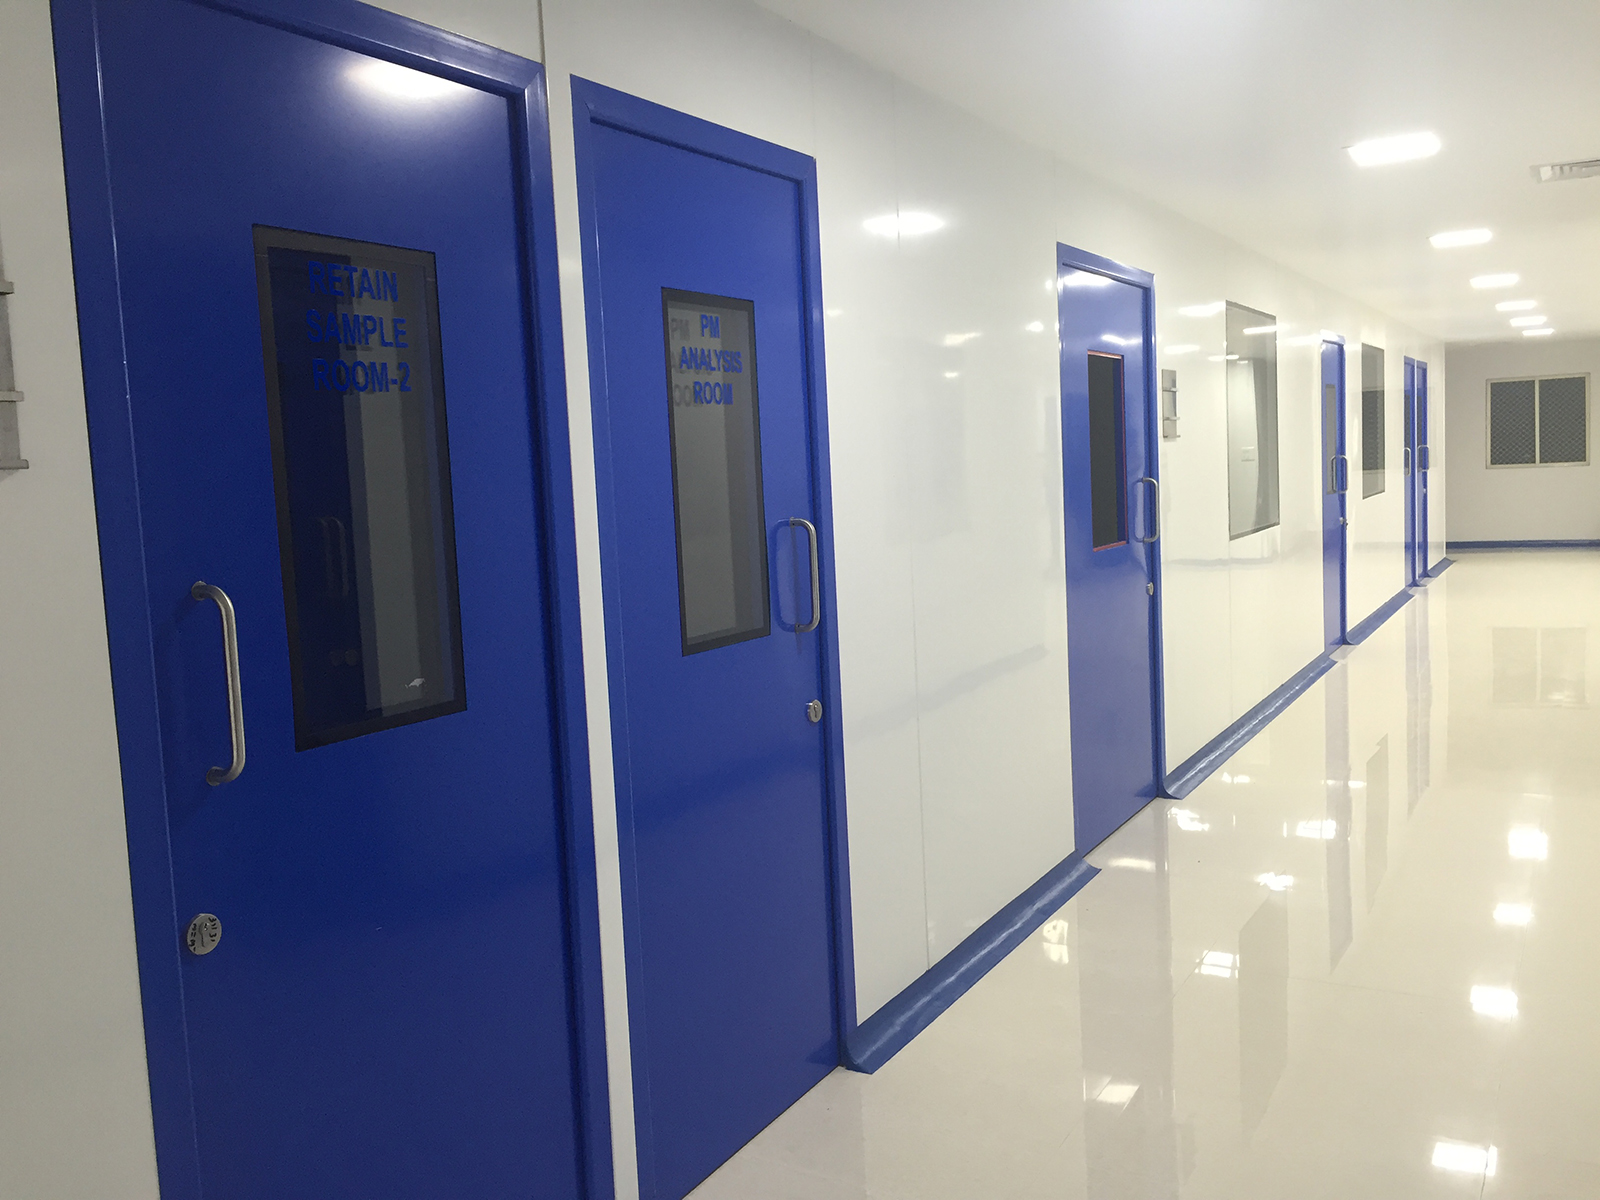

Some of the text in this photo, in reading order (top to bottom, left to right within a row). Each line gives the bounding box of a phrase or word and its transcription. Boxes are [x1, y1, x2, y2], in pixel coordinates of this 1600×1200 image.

[308, 261, 398, 302] RETAIN
[306, 309, 409, 349] SAMPLE
[700, 314, 720, 339] PM
[680, 346, 742, 373] ANALYSIS
[312, 358, 412, 392] ROOM-2
[693, 381, 733, 405] ROOM
